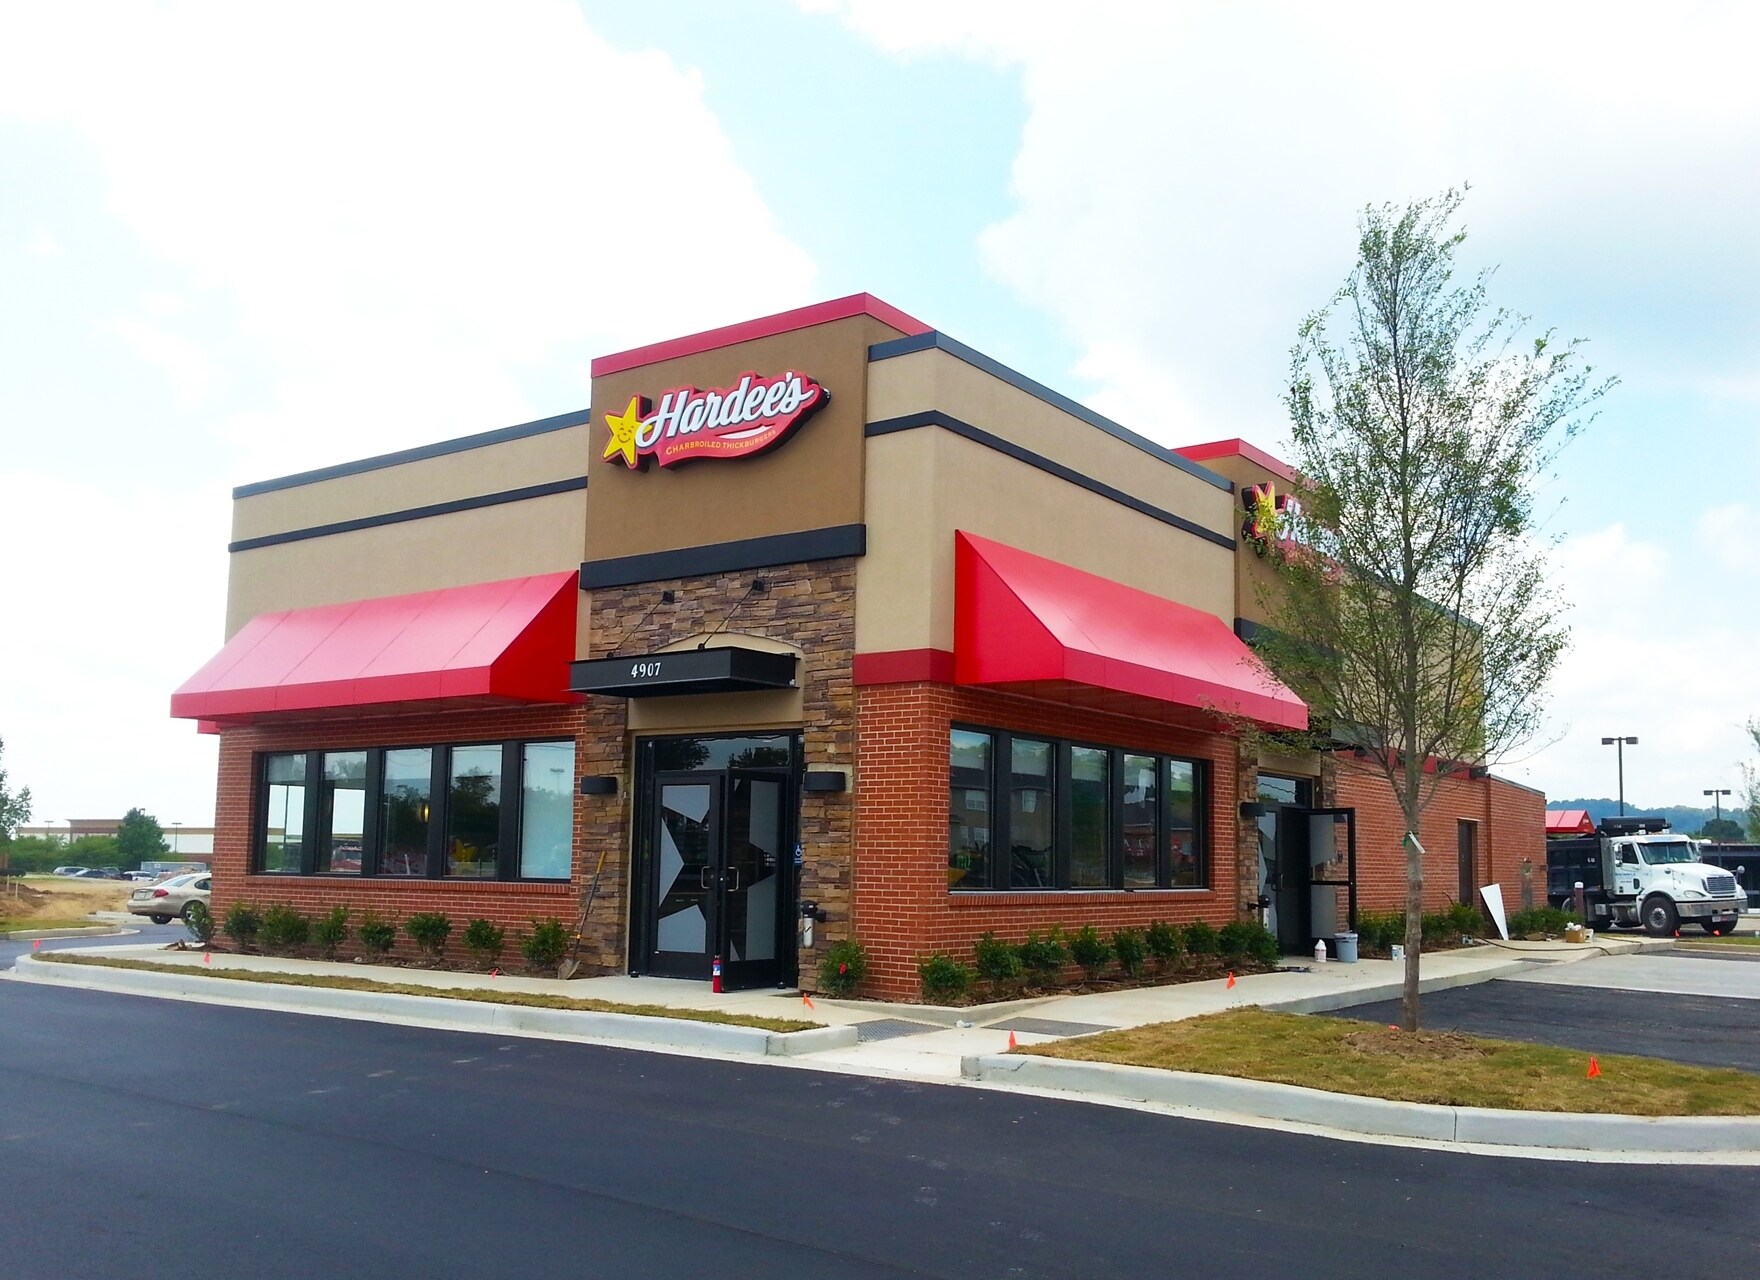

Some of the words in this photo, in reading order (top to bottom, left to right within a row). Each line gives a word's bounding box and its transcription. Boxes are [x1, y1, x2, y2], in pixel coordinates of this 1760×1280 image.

[635, 371, 814, 448] Hardee's
[665, 441, 720, 455] CHARBROILED
[723, 429, 776, 449] THICKBURGERS
[631, 662, 661, 678] 4907
